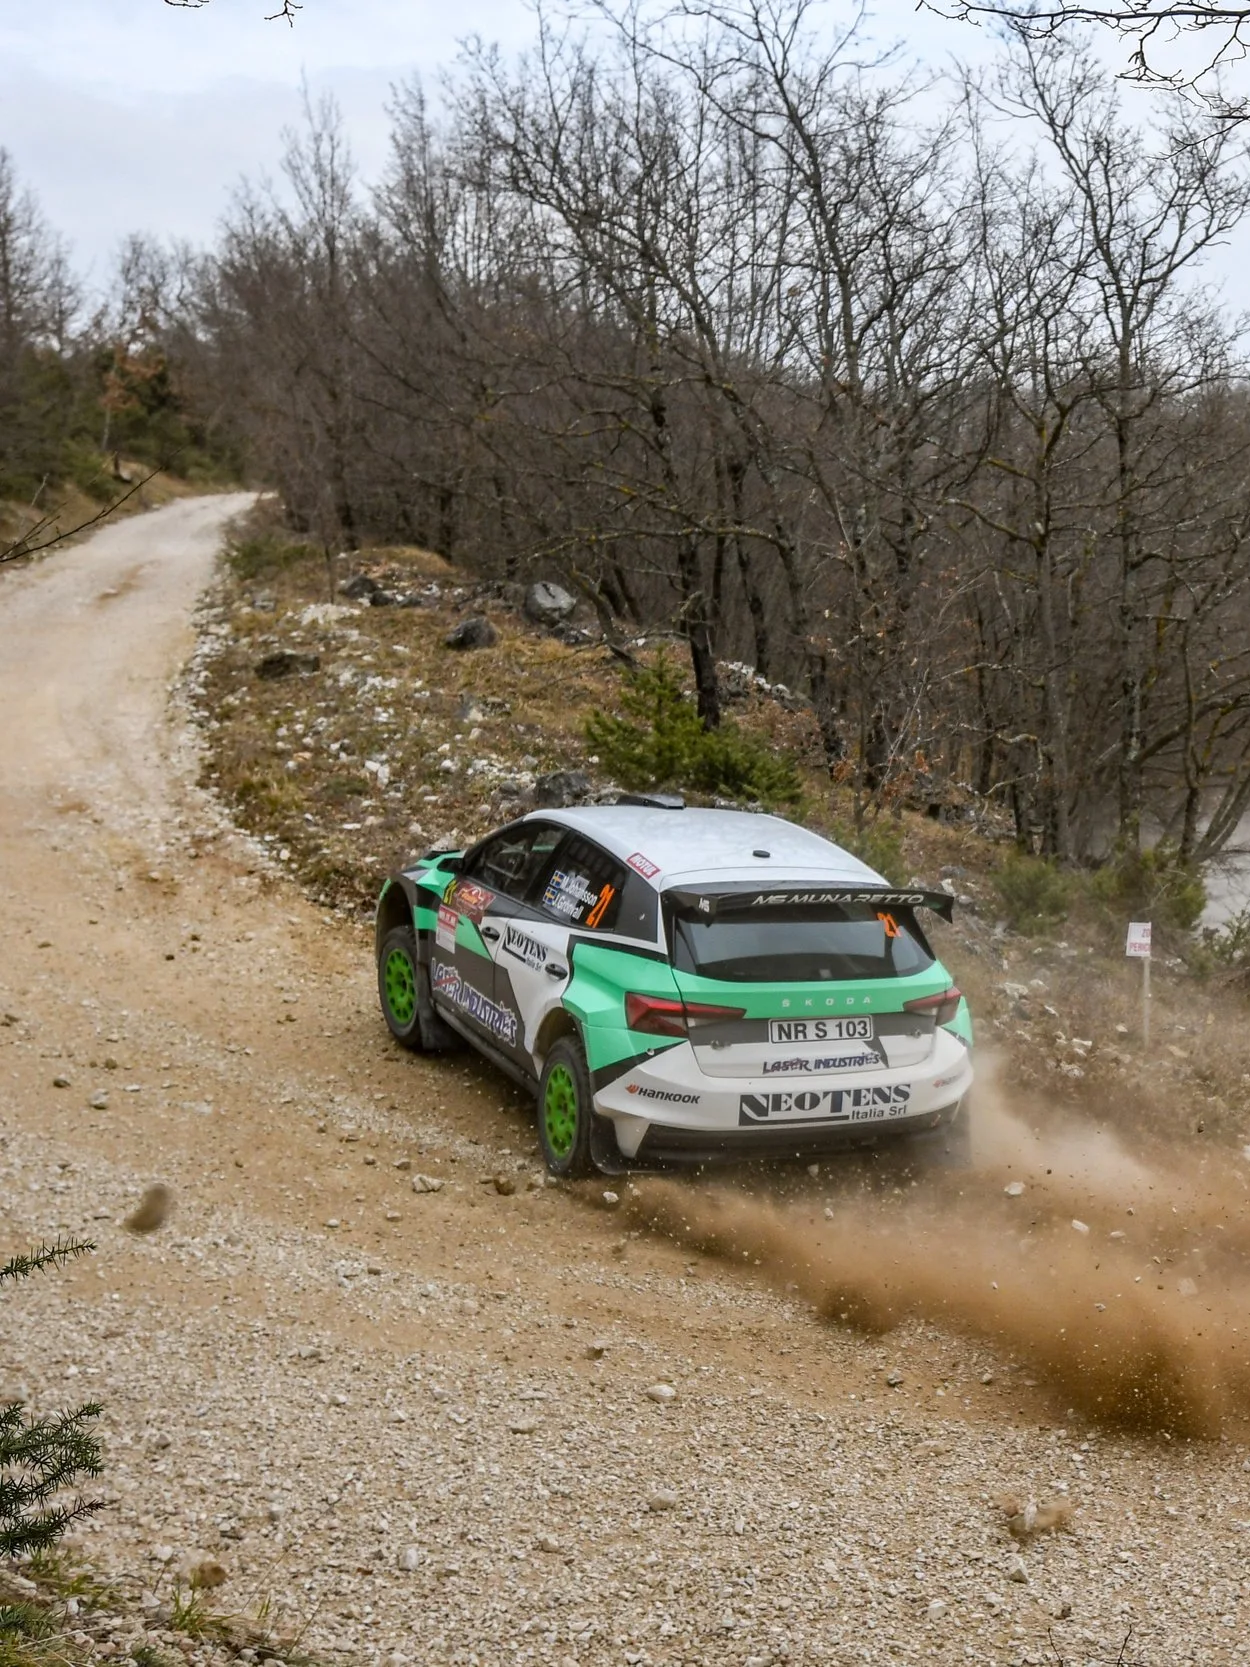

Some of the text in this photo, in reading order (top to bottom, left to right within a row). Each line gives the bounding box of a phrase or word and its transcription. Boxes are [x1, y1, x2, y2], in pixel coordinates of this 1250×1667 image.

[630, 855, 657, 876] MOTUL
[585, 884, 615, 929] 21
[787, 894, 924, 904] MUNARETTO
[876, 912, 903, 937] 21
[502, 926, 548, 962] NEOTENS
[777, 1020, 868, 1040] NR S 103
[738, 1083, 911, 1126] NEOTENS
[851, 1105, 907, 1120] Italia Srl
